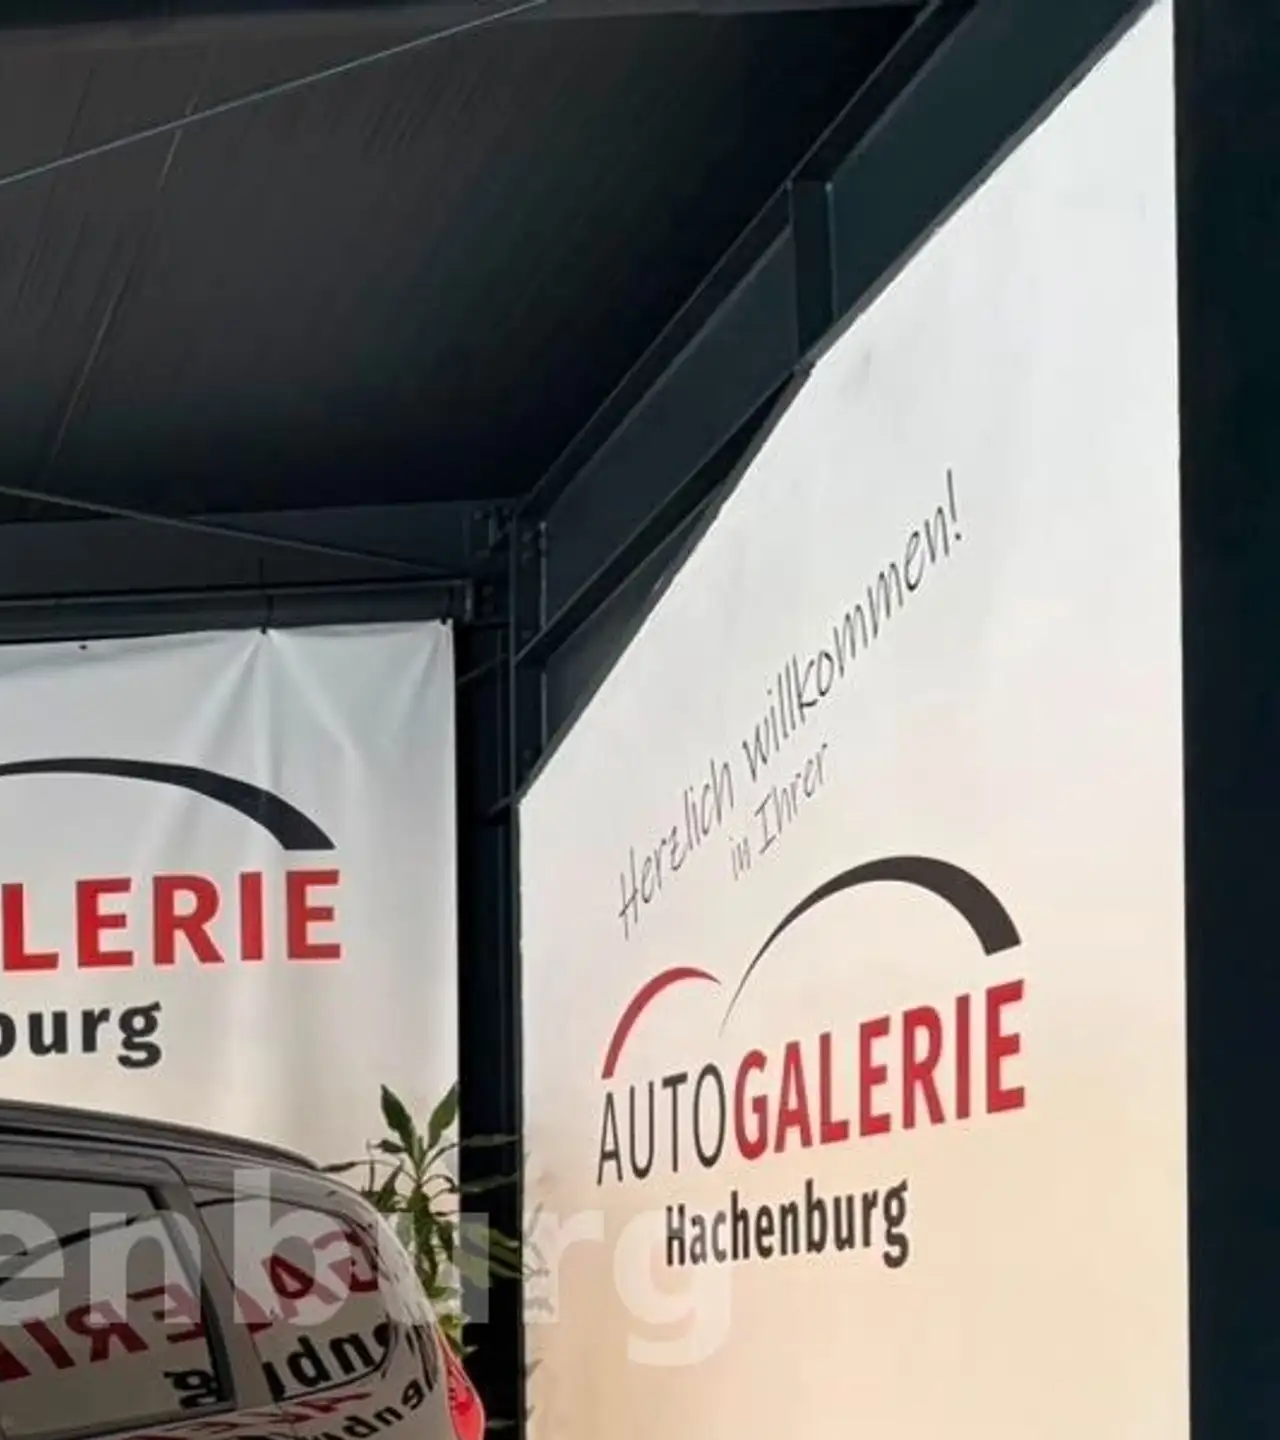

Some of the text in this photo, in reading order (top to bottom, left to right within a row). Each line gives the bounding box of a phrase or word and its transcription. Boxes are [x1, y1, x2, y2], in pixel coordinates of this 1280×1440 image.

[618, 469, 961, 940] Herzlich willkommen!
[729, 743, 828, 881] in Ihrer
[597, 979, 1025, 1186] AUTOGALERIE
[666, 1178, 909, 1269] Hachenburg
